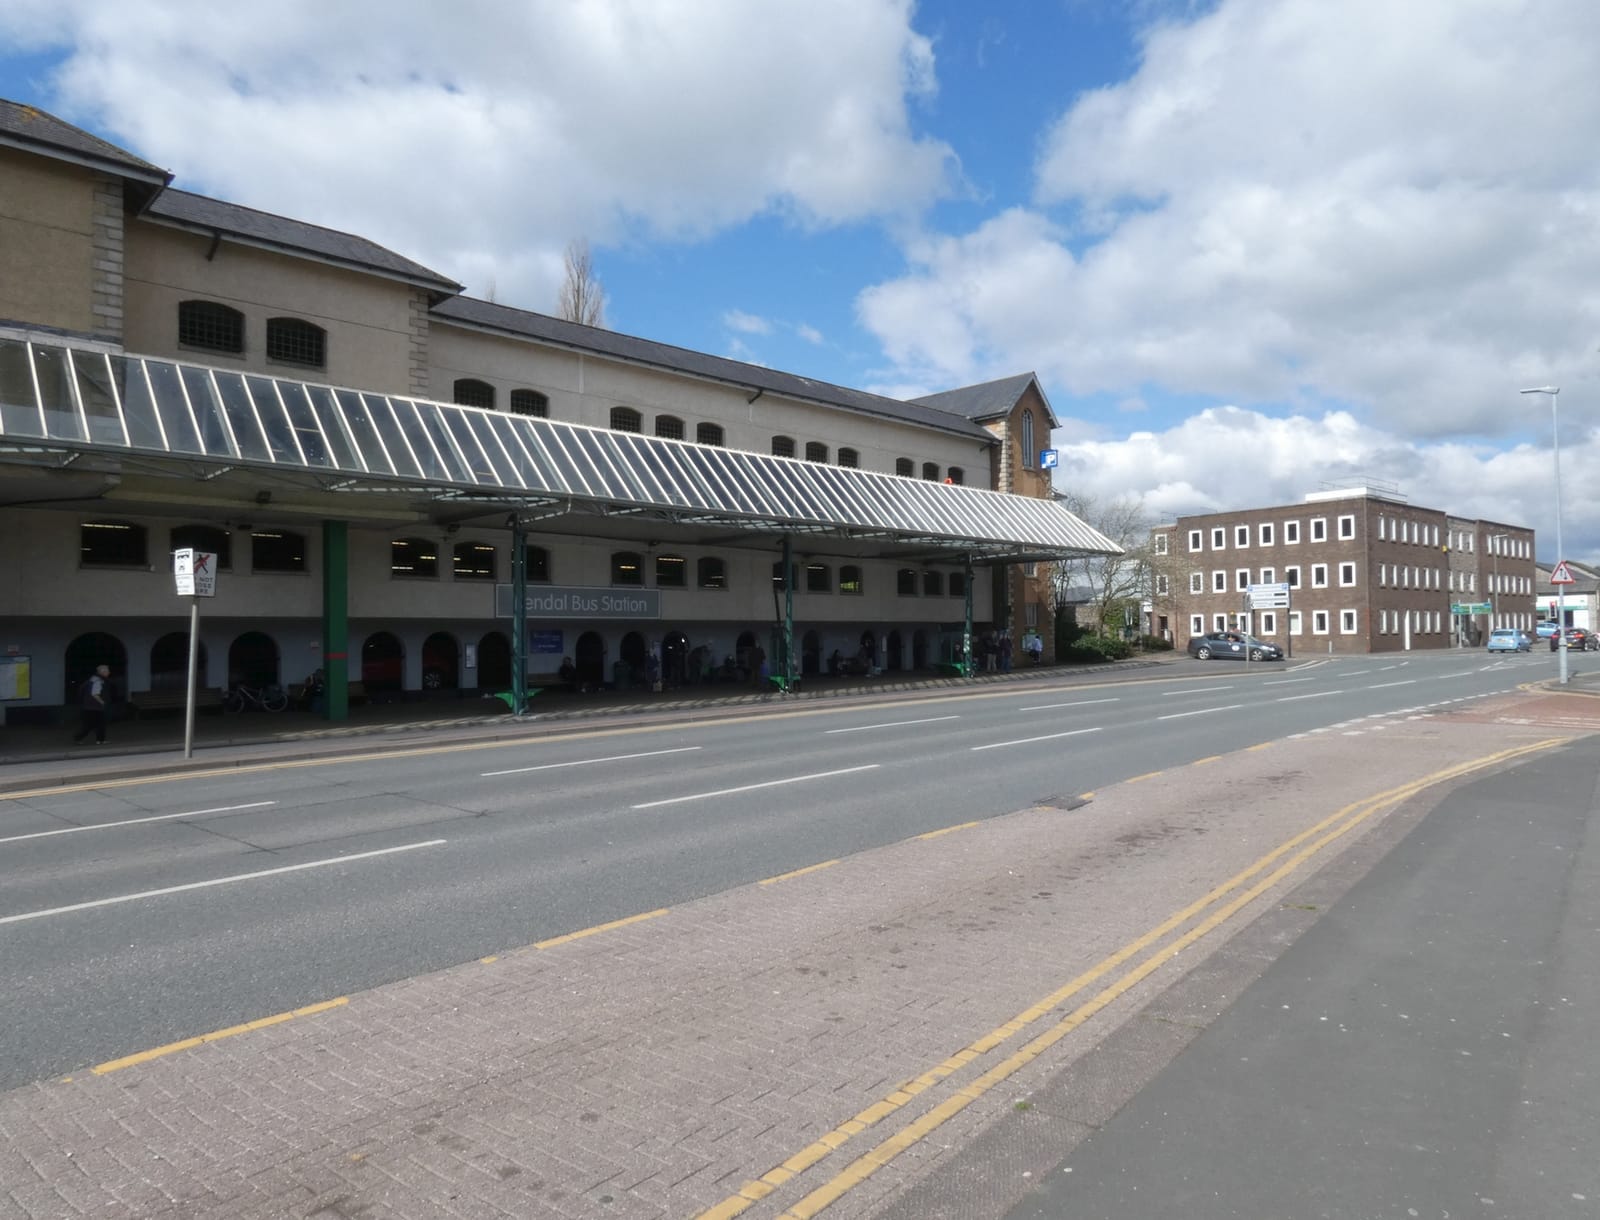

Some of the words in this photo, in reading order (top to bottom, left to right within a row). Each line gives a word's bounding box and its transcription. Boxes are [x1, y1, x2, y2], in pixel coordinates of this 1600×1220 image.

[525, 594, 567, 610] endal
[572, 595, 598, 611] Bus
[602, 596, 647, 612] Station
